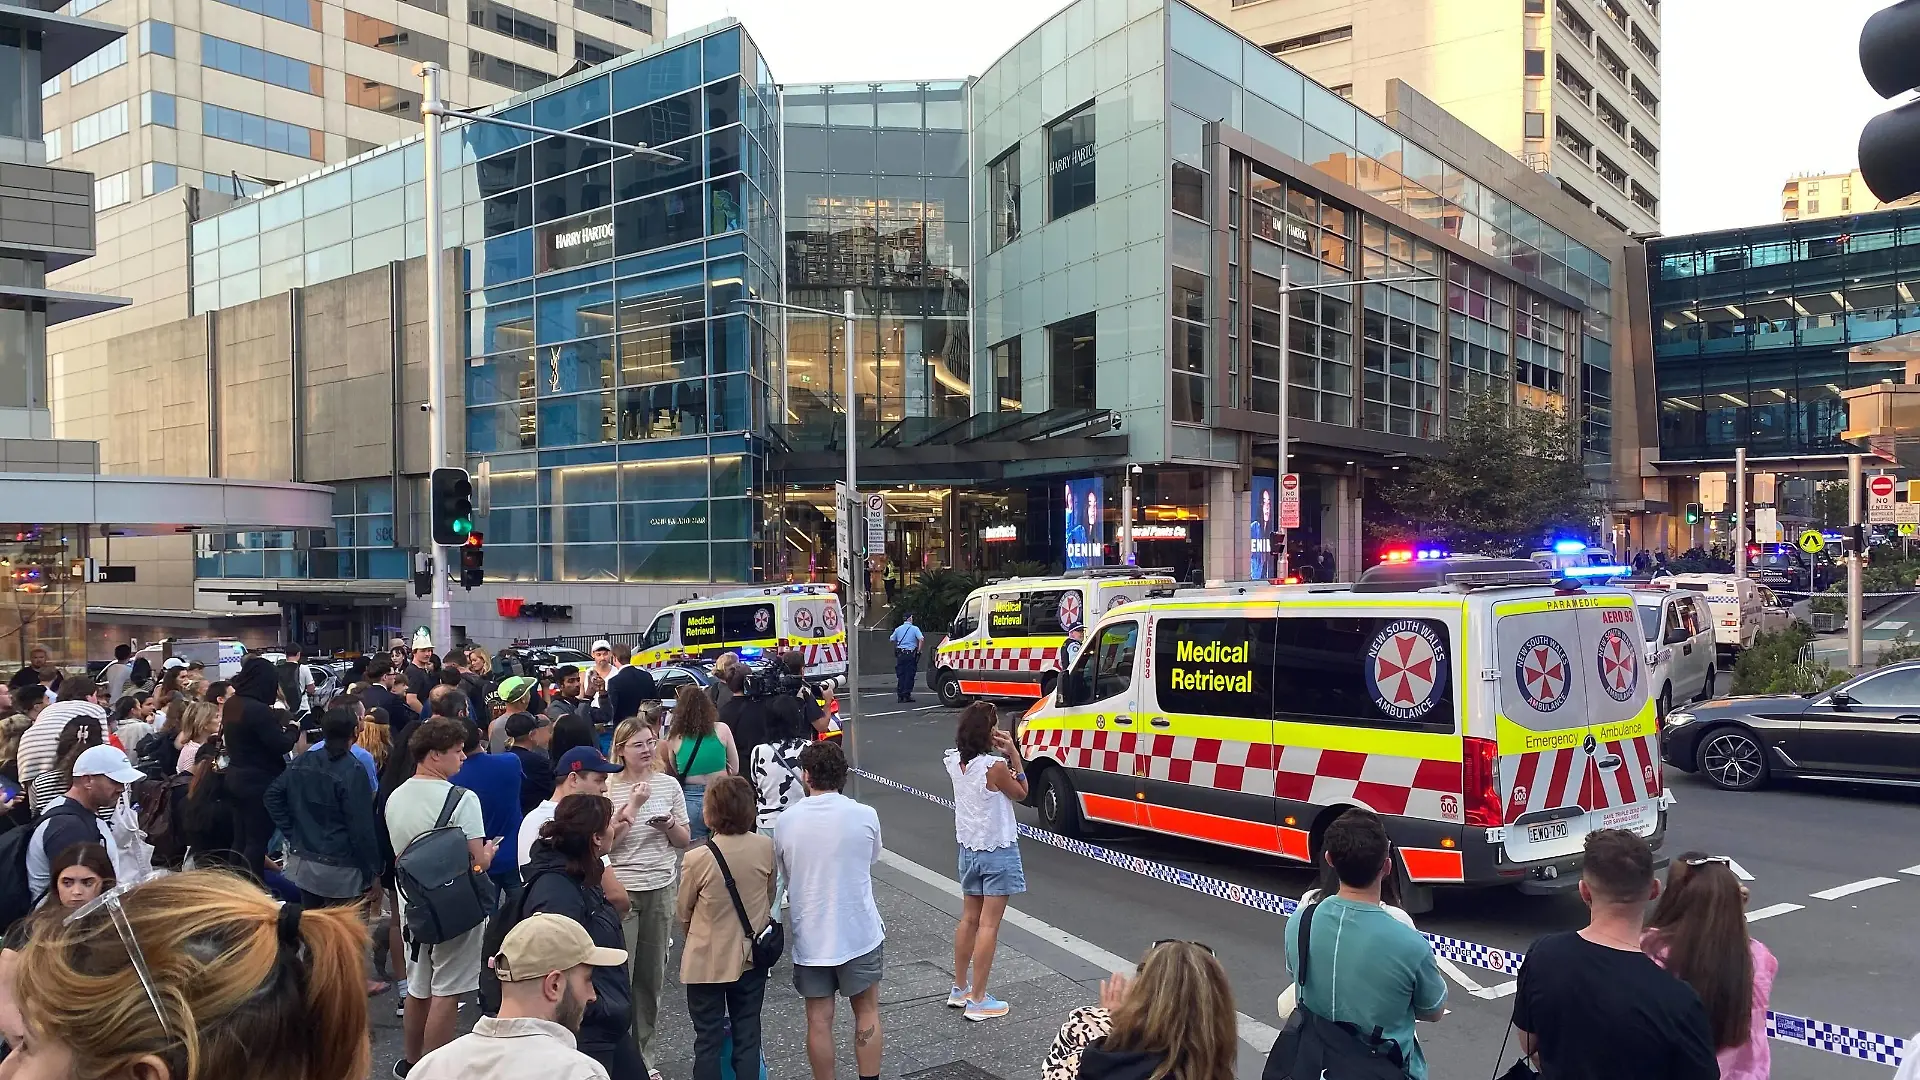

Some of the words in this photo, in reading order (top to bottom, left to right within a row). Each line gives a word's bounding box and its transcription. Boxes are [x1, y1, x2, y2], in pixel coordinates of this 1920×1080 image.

[1050, 154, 1071, 176] HARRY
[556, 230, 582, 250] HARRY
[582, 222, 614, 244] HARTOG
[1117, 526, 1150, 537] Geral
[1150, 526, 1174, 537] Pants
[1068, 542, 1100, 556] DENIM
[996, 600, 1022, 612] Medical
[1547, 598, 1599, 609] PARAMEDIC
[688, 615, 714, 626] Medical
[992, 614, 1022, 626] Retrieval
[1602, 612, 1624, 624] AERO
[1624, 611, 1634, 622] 93
[686, 626, 716, 636] Retrieval
[1368, 632, 1386, 658] NEW
[1386, 620, 1420, 636] SOUTH
[1420, 625, 1445, 662] WALES
[1176, 640, 1248, 662] Medical
[1517, 647, 1528, 668] NEW
[1526, 636, 1548, 650] SOUTH
[1550, 640, 1569, 666] WALES
[1172, 668, 1252, 692] Retrieval
[1606, 684, 1634, 700] AMBULANCE
[1376, 698, 1434, 718] AMBULANCE
[1528, 692, 1566, 711] AMBULANCE
[1526, 732, 1579, 748] Emergency
[1600, 723, 1642, 738] Ambulance
[1514, 792, 1526, 800] 000
[1441, 803, 1457, 813] 000
[1440, 944, 1471, 957] POLICE
[1826, 1034, 1876, 1052] POLICE
